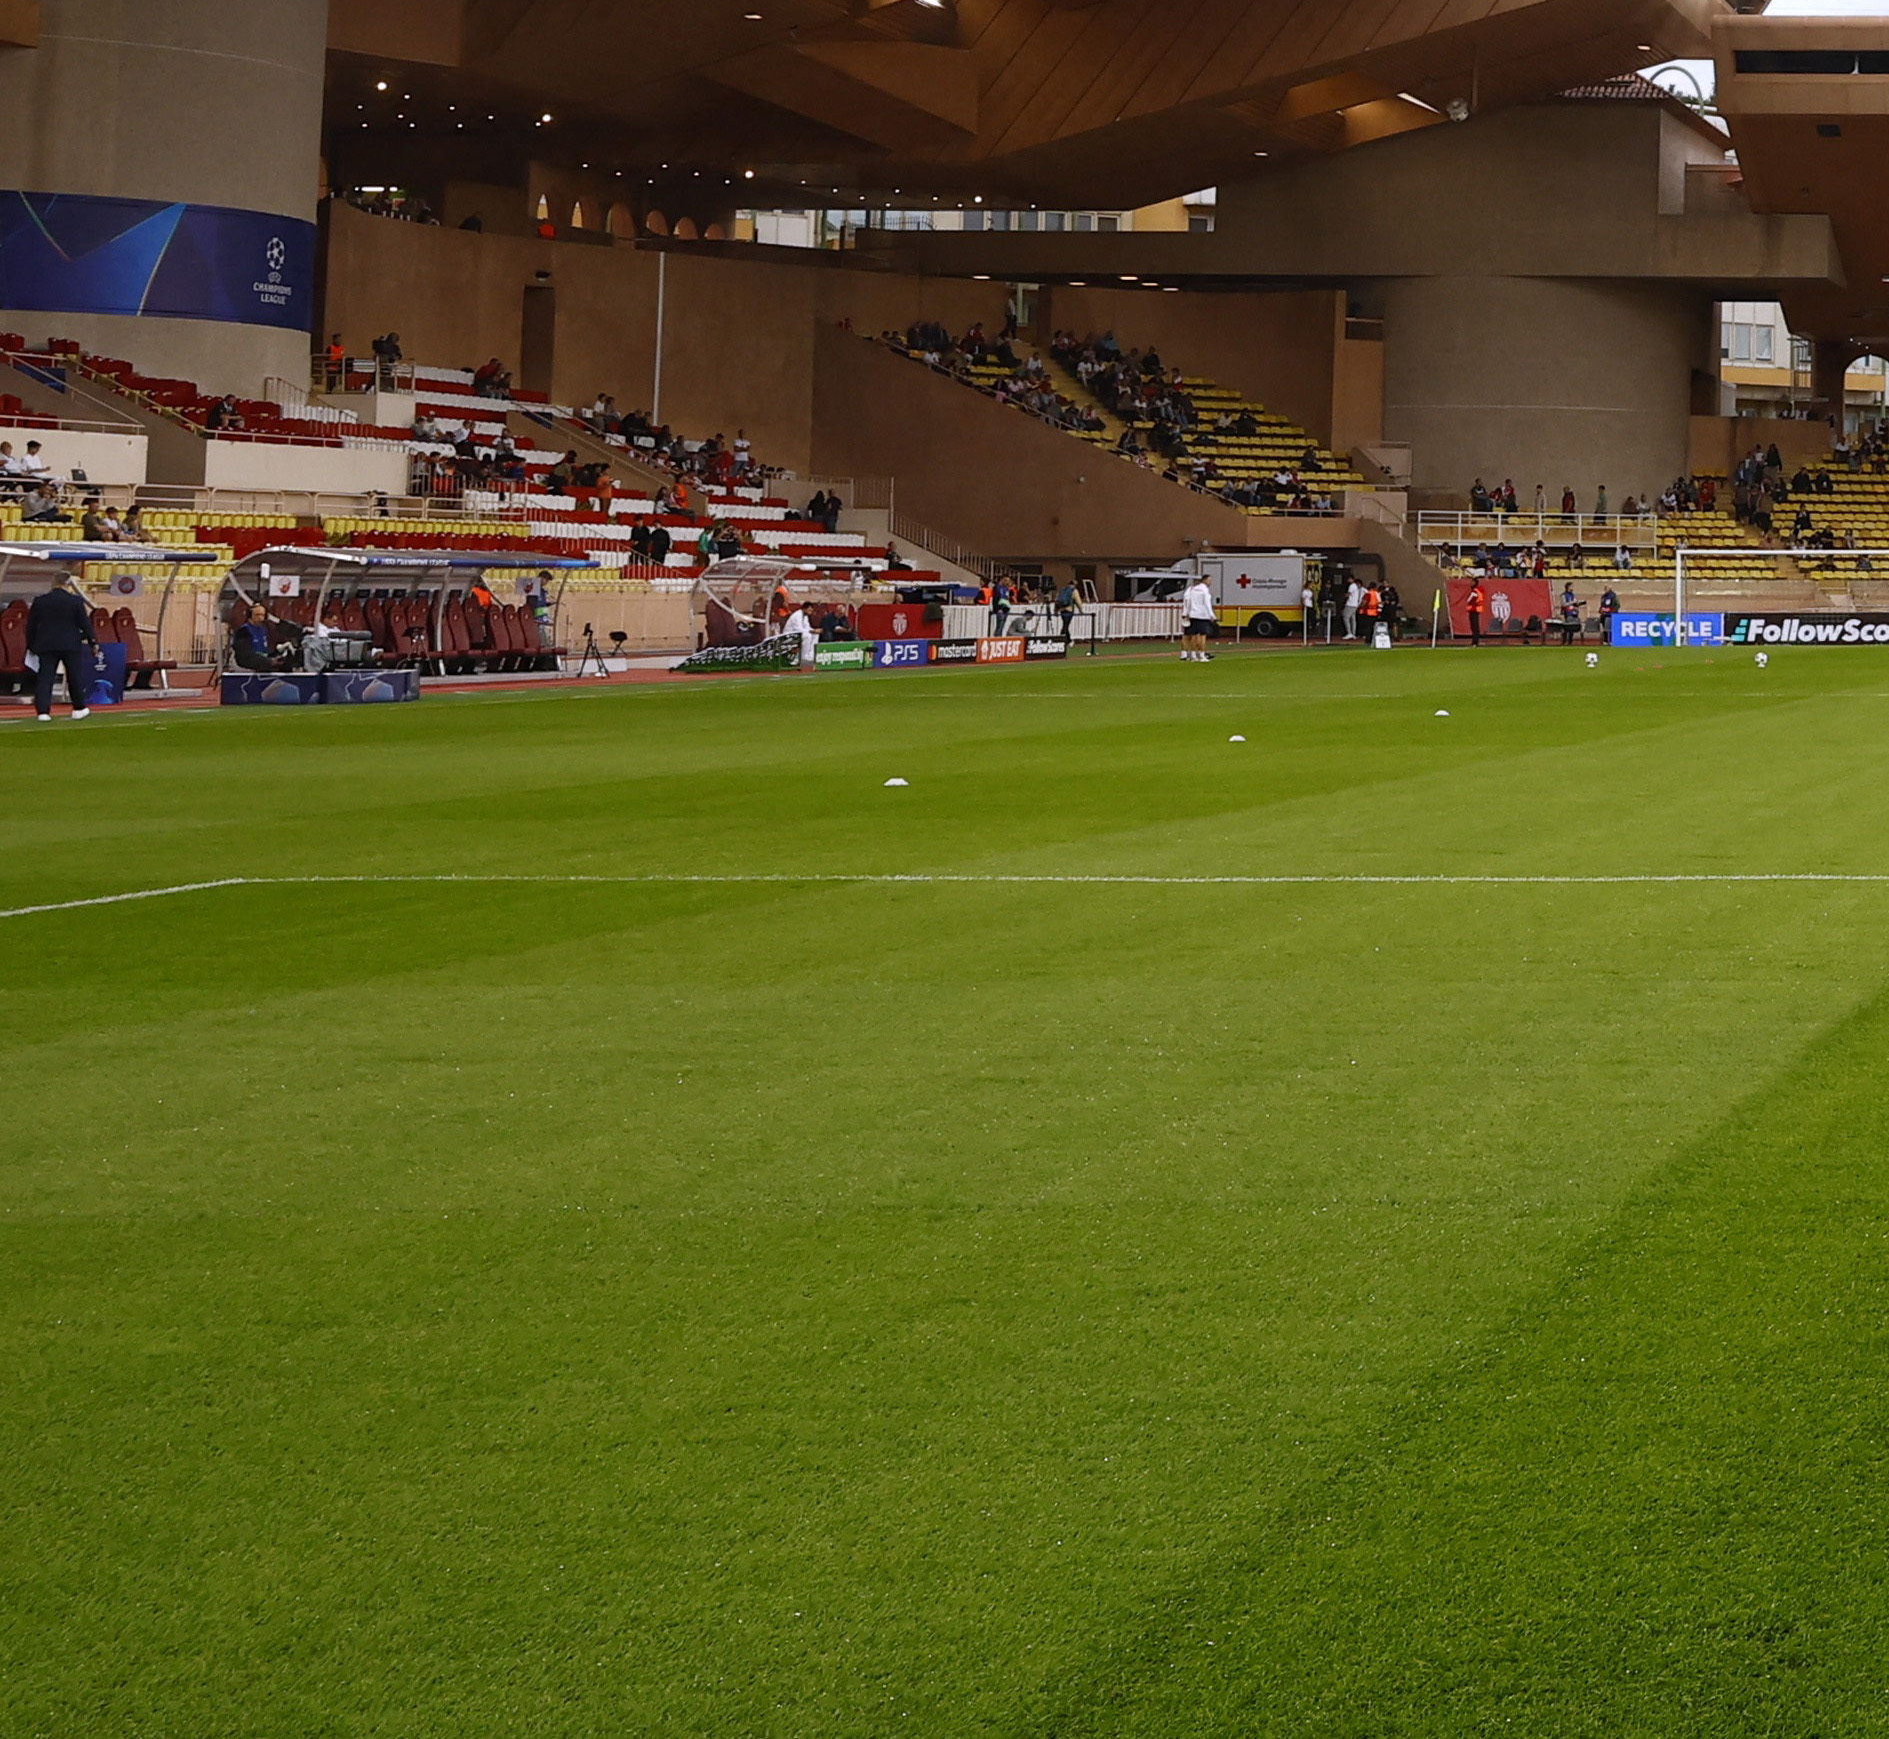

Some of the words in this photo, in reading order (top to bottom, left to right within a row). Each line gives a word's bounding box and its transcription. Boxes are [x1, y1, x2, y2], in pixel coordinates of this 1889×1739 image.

[253, 282, 292, 296] CHAMPIONS
[261, 293, 286, 305] LEAGUE
[1621, 621, 1712, 637] RECYCLE
[894, 644, 919, 661] PS5
[938, 641, 976, 658] mastercard
[989, 640, 1006, 660] JUST
[1007, 640, 1021, 657] EAT
